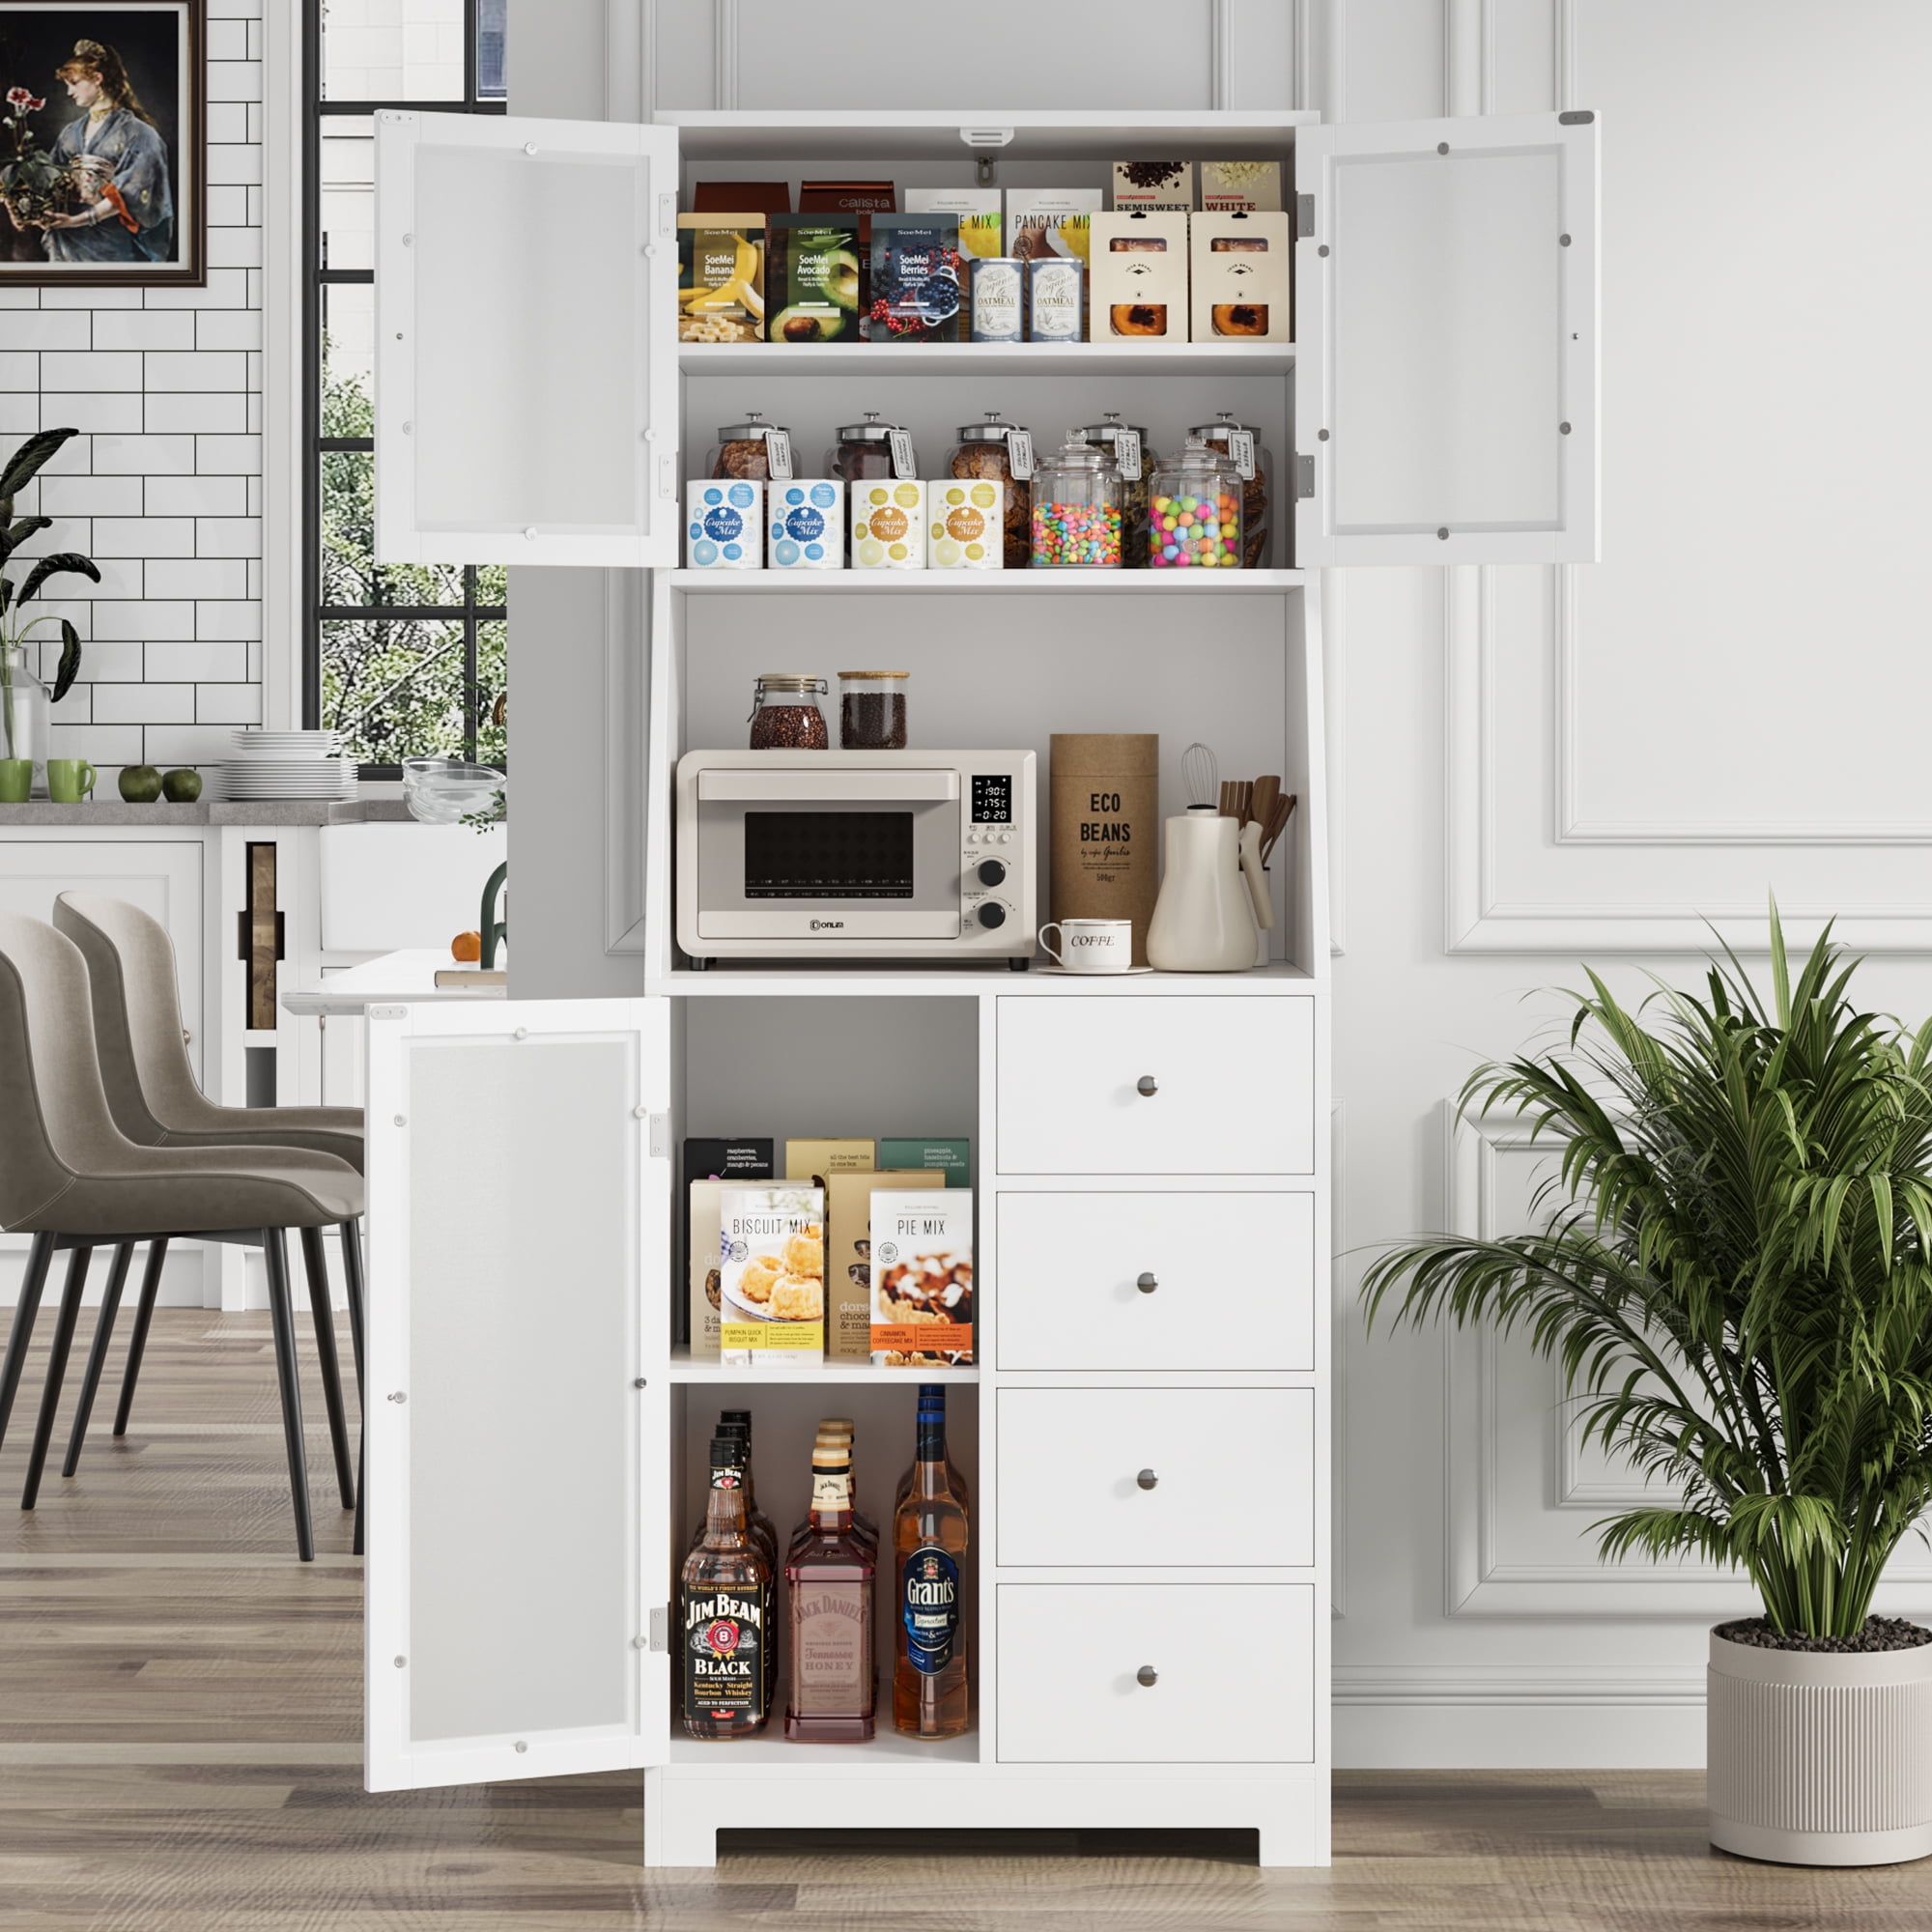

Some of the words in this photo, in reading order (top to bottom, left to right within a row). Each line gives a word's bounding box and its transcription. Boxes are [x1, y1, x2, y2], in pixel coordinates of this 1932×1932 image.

[1117, 203, 1190, 212] SEMISWEET
[1206, 202, 1256, 212] WHITE
[972, 214, 992, 230] MIX
[1015, 214, 1066, 230] PANCAKE
[704, 255, 734, 265] SoeMei
[799, 254, 829, 265] SoeMei
[899, 254, 929, 265] SoeMei
[704, 265, 734, 274] Banana
[797, 265, 831, 274] Avocado
[900, 265, 928, 275] Berries
[705, 518, 741, 527] Cupcake
[787, 518, 823, 527] Cupcake
[871, 518, 905, 527] Cupcake
[948, 518, 982, 527] Cupcake
[716, 526, 737, 535] Mix
[797, 526, 819, 535] Mix
[881, 526, 902, 535] Mix
[958, 526, 980, 535] Mix
[1091, 793, 1121, 812] ECO
[1080, 823, 1130, 842] BEANS
[733, 1219, 781, 1235] BISCUIT
[790, 1219, 810, 1235] MIX
[897, 1220, 917, 1236] PIE
[923, 1220, 945, 1236] MIX
[713, 1470, 724, 1480] JIM
[908, 1577, 953, 1604] Grant's
[686, 1600, 715, 1630] JIM
[717, 1594, 761, 1630] BEAM
[796, 1600, 821, 1624] JACK
[719, 1631, 728, 1641] B
[806, 1648, 853, 1660] Tennessee
[695, 1659, 752, 1675] BLACK
